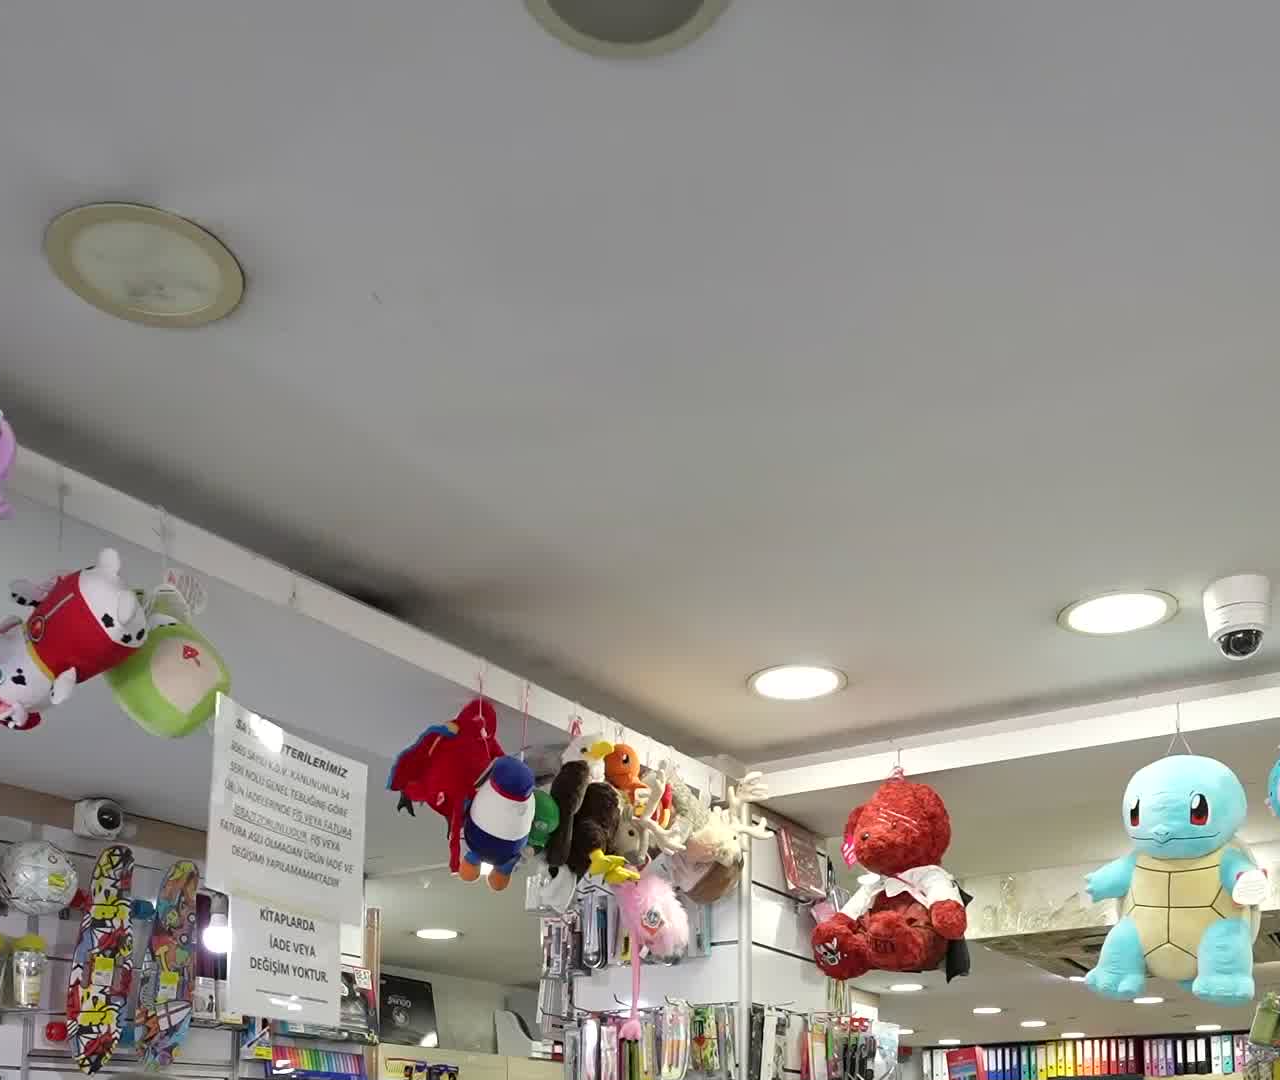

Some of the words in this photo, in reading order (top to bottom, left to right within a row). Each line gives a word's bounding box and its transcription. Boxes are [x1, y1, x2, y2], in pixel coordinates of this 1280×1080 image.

[259, 906, 316, 933] KİTAPLARDA
[269, 933, 291, 953] İADE
[292, 942, 317, 958] VEYA
[249, 956, 290, 977] DEĞİŞİM
[291, 965, 329, 984] YOKTUR.
